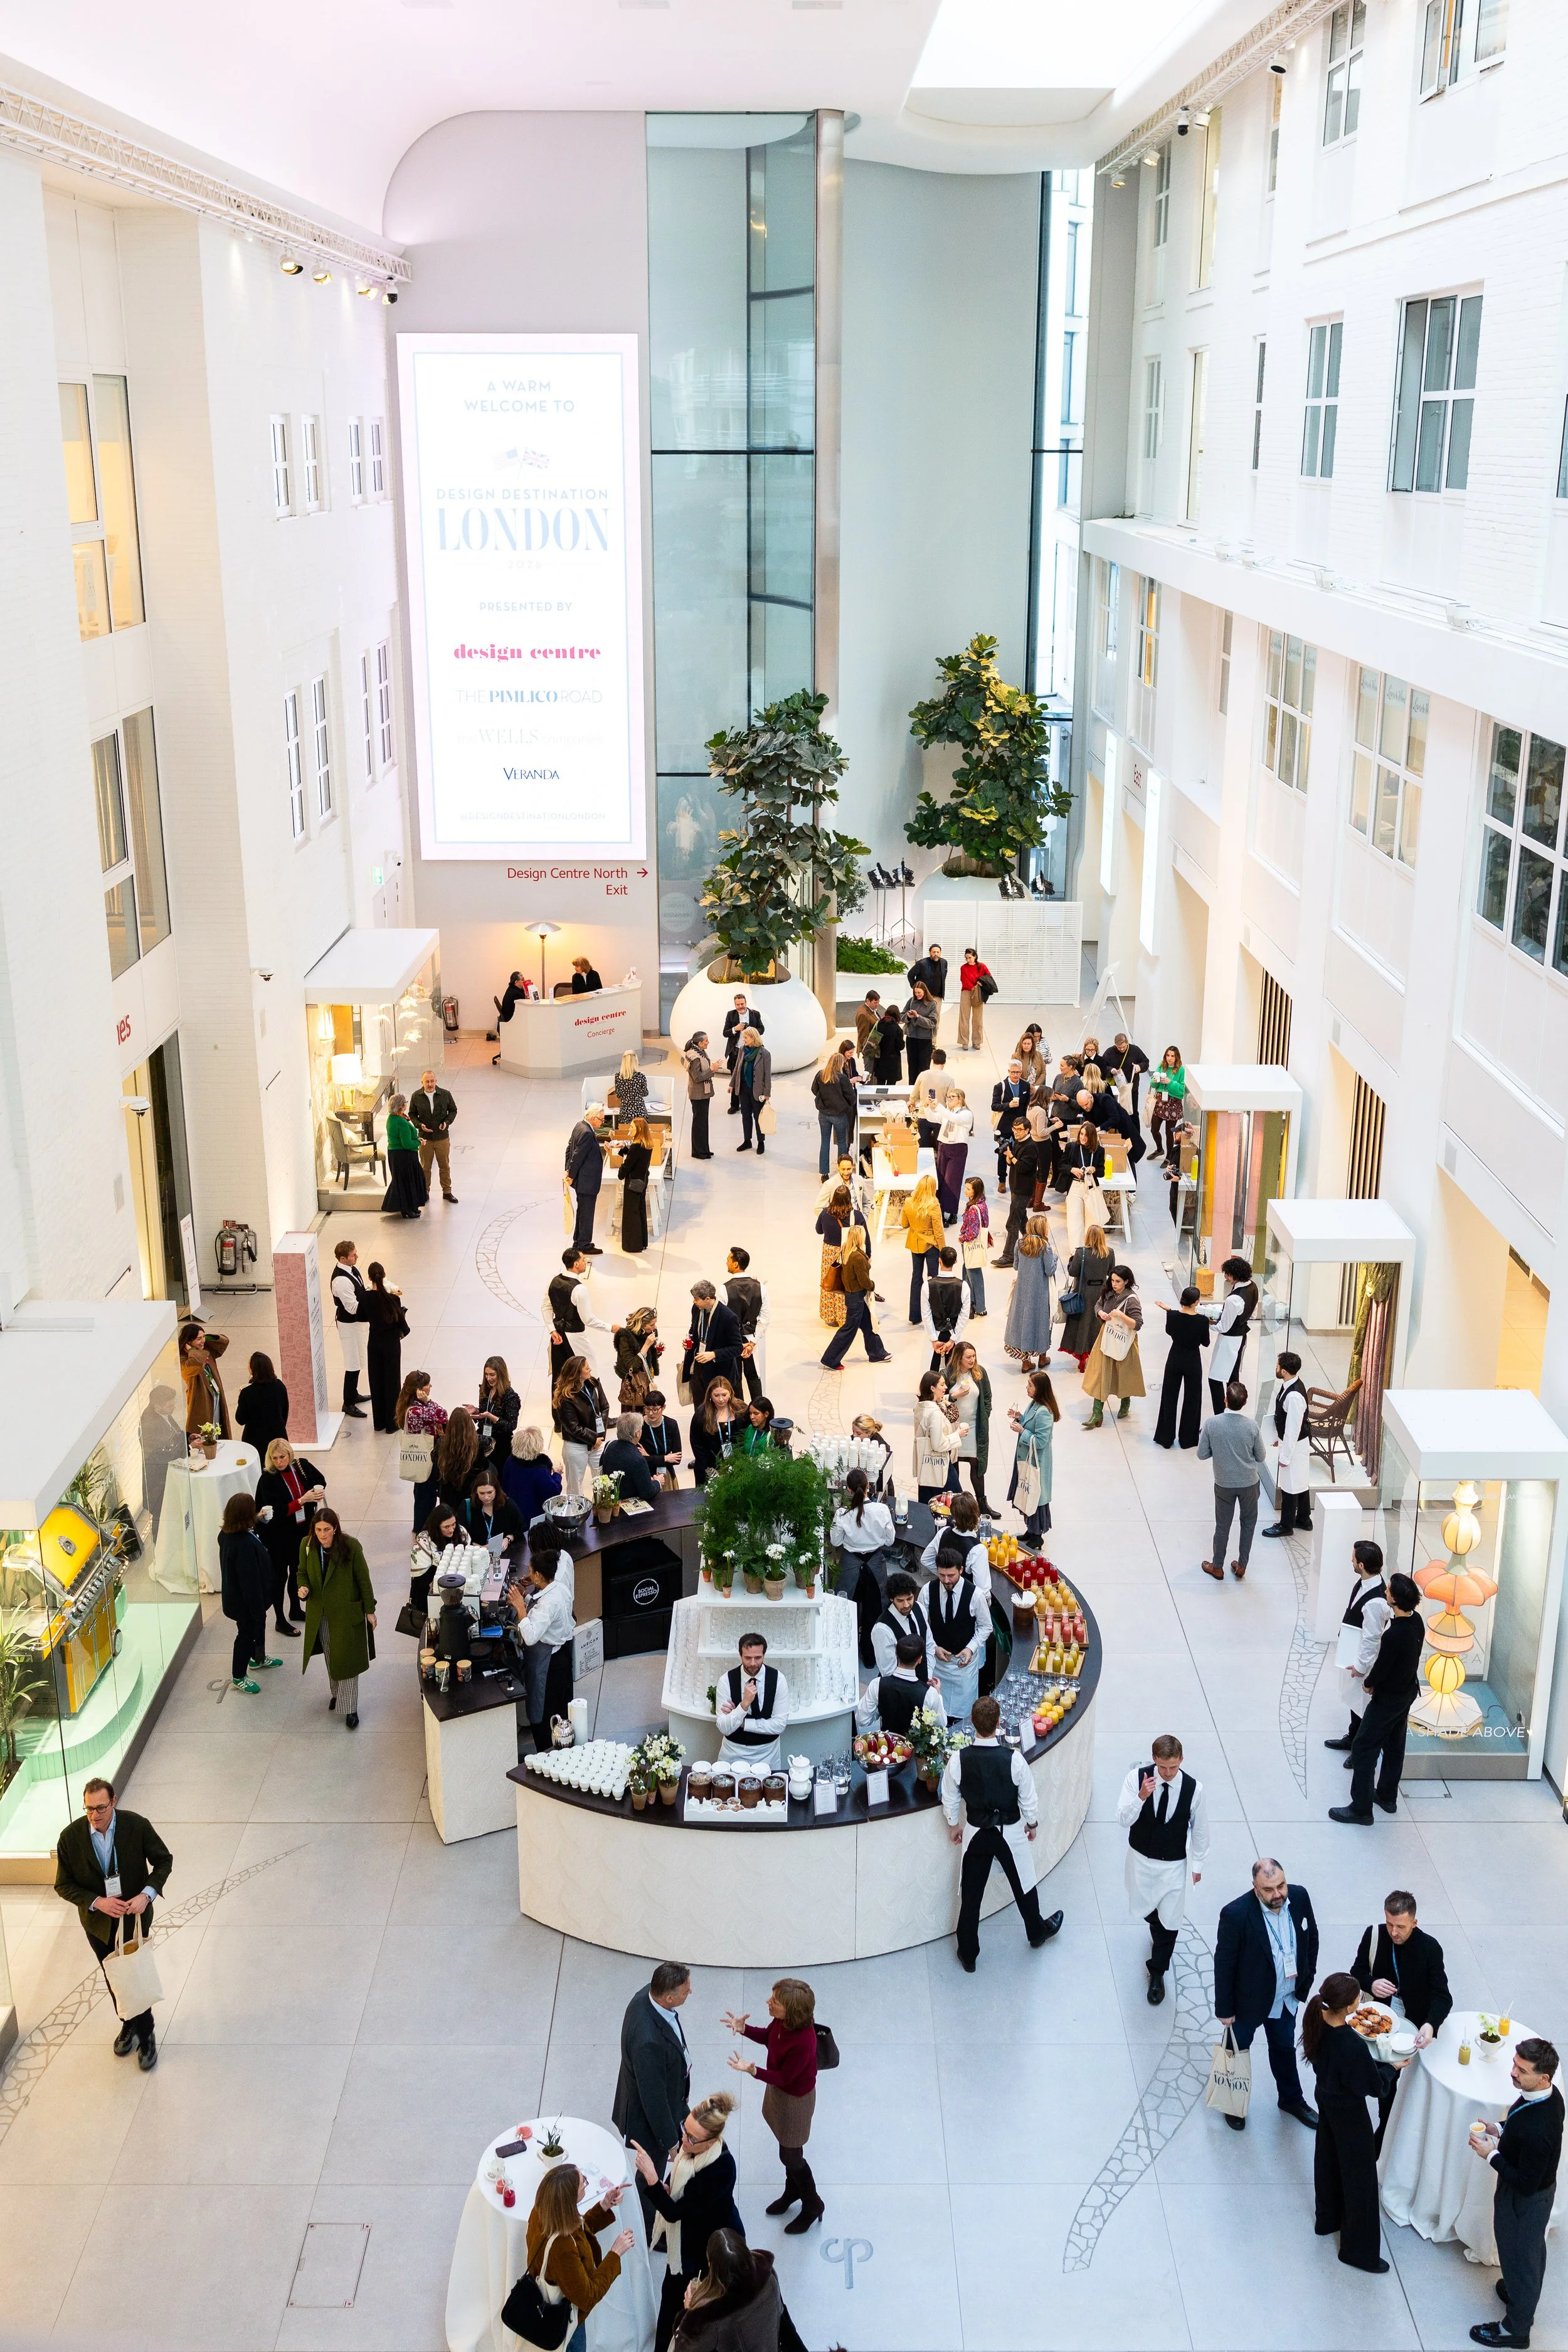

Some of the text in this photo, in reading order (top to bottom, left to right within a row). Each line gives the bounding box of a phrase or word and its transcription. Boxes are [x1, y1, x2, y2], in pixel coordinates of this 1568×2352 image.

[487, 379, 551, 392] A WARM
[464, 400, 575, 413] WELCOME TO
[437, 488, 608, 500] DESIGN DESTINATION
[438, 507, 609, 551] LONDON
[480, 601, 572, 612] PRESENTED BY
[453, 644, 601, 662] design centre
[456, 690, 603, 704] THE PIMLICO ROAD
[479, 728, 539, 744] WELLS
[502, 767, 560, 781] VERANDA
[507, 867, 628, 882] Design Centre North
[606, 884, 628, 896] Exit
[574, 1015, 600, 1027] design
[601, 1010, 627, 1020] centre
[586, 1027, 615, 1039] Concierge
[1106, 1326, 1128, 1343] LODON
[635, 1589, 657, 1599] ESPRESSO
[637, 1586, 655, 1594] SOCIAL
[580, 1636, 599, 1650] AMBICAN
[1407, 1727, 1414, 1737] A
[1472, 1726, 1526, 1738] ABOVE
